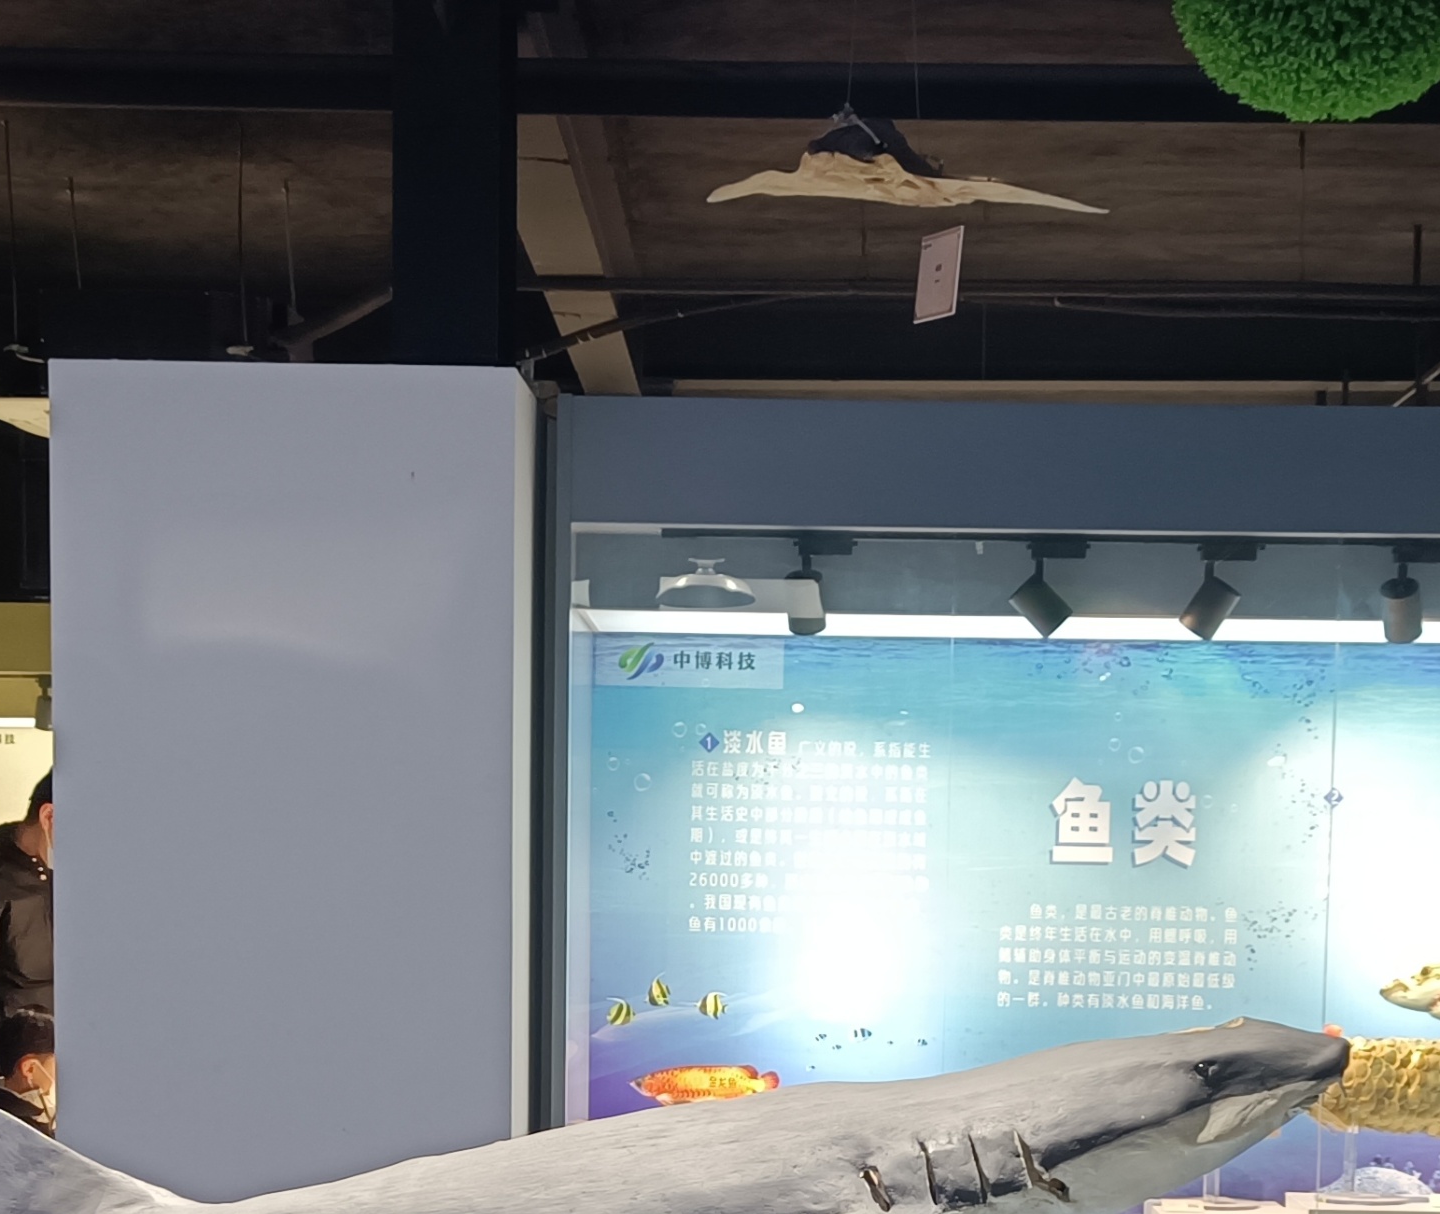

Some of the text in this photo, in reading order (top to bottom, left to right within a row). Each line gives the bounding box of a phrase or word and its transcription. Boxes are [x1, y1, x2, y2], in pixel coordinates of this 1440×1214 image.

[672, 650, 757, 672] 中博科技
[723, 729, 787, 755] 淡水鱼
[1050, 777, 1197, 868] 鱼类
